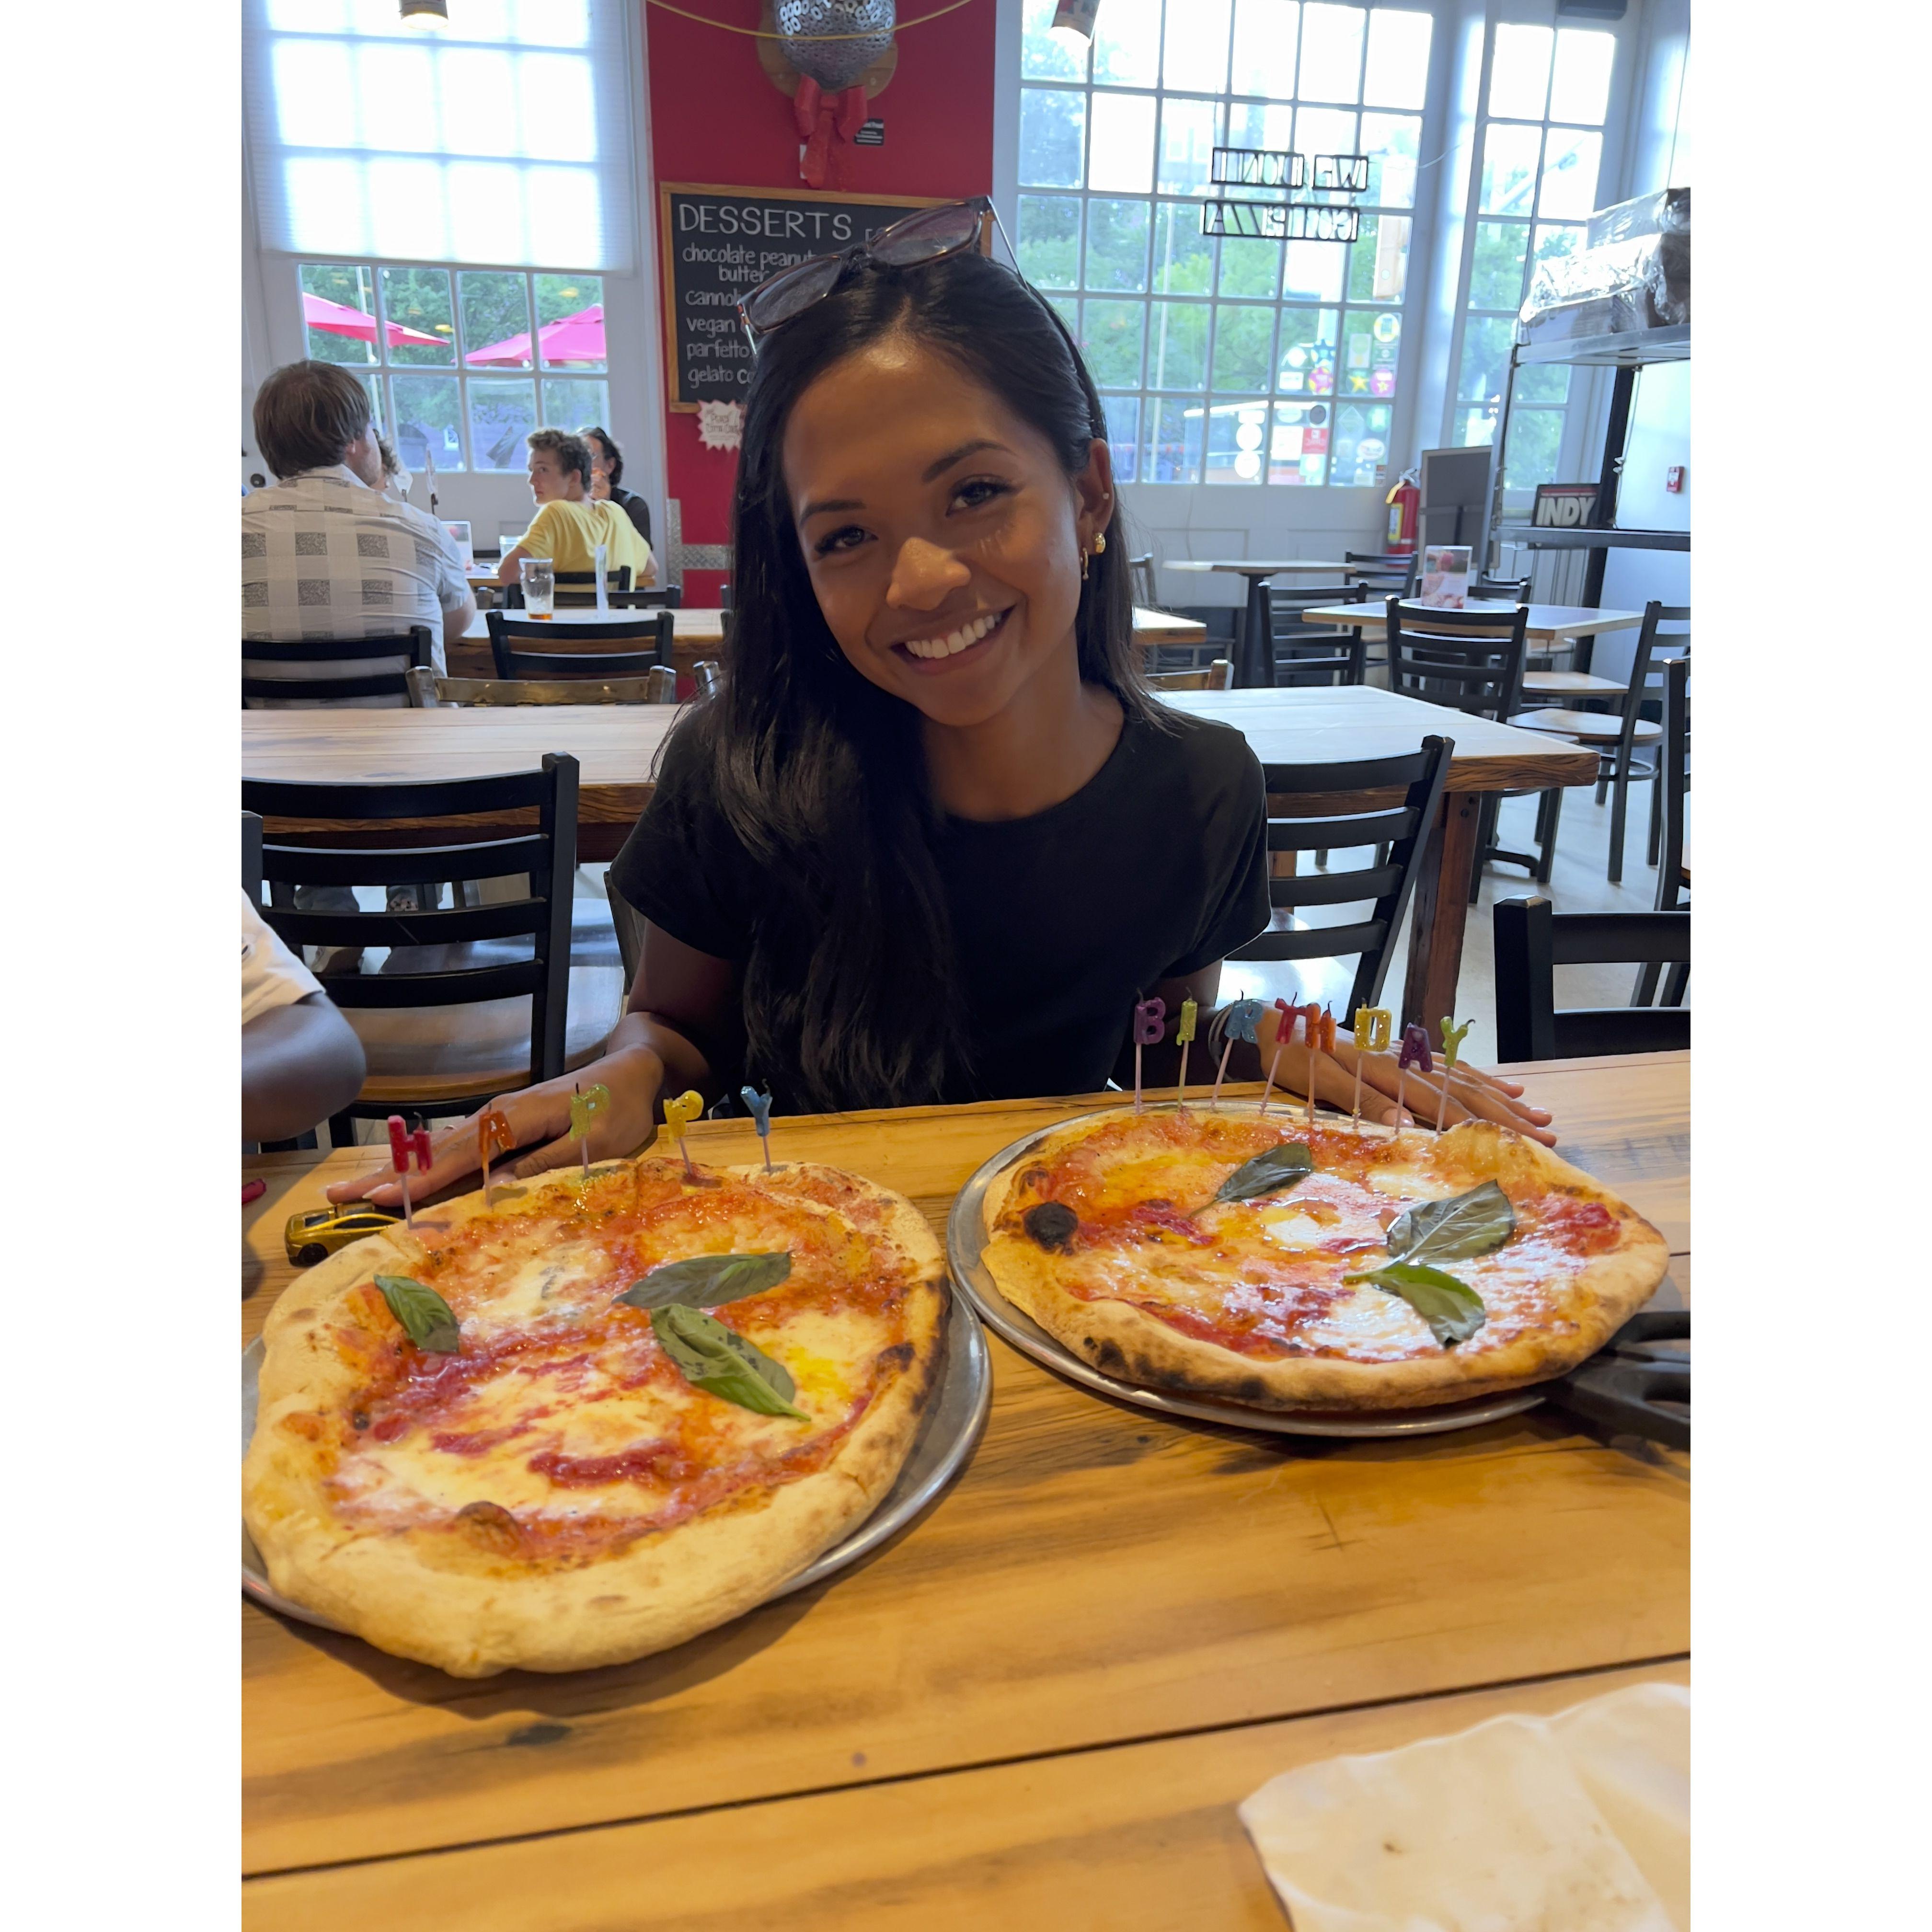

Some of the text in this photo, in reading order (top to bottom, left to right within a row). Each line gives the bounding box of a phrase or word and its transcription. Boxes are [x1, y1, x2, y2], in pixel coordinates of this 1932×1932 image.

[678, 203, 852, 240] DESSERTS
[682, 242, 756, 264] chocolate
[718, 264, 770, 283] butter
[686, 317, 736, 338] vegan
[686, 339, 750, 361] parfetto
[688, 364, 734, 389] gelato
[1535, 497, 1597, 527] INDY
